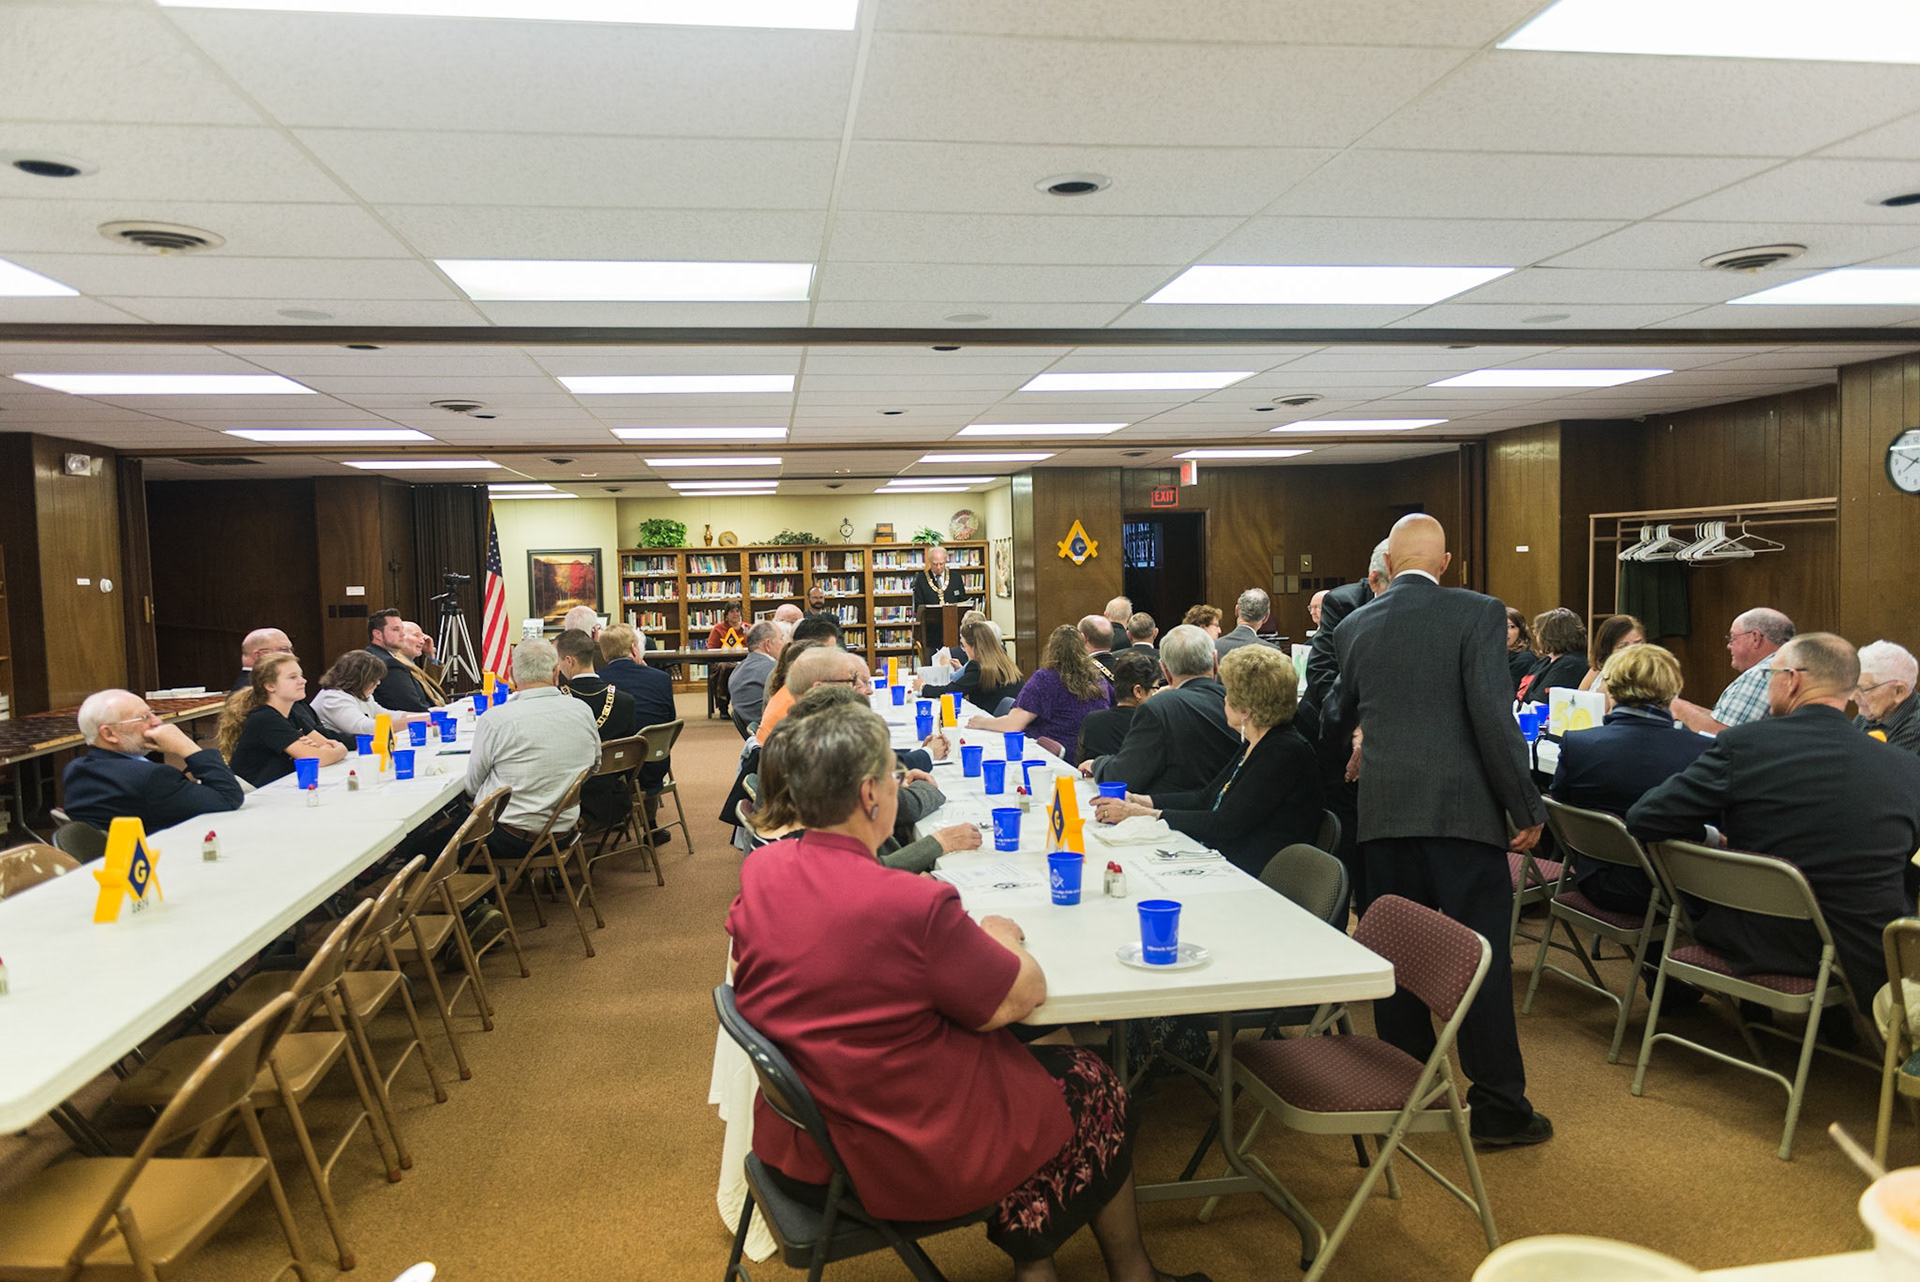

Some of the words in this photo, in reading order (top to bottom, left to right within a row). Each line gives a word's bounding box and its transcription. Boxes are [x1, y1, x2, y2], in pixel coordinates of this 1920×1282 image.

[1154, 490, 1174, 502] EXIT
[1071, 537, 1088, 556] G
[728, 637, 734, 645] G
[1053, 810, 1061, 830] G
[133, 859, 147, 884] G
